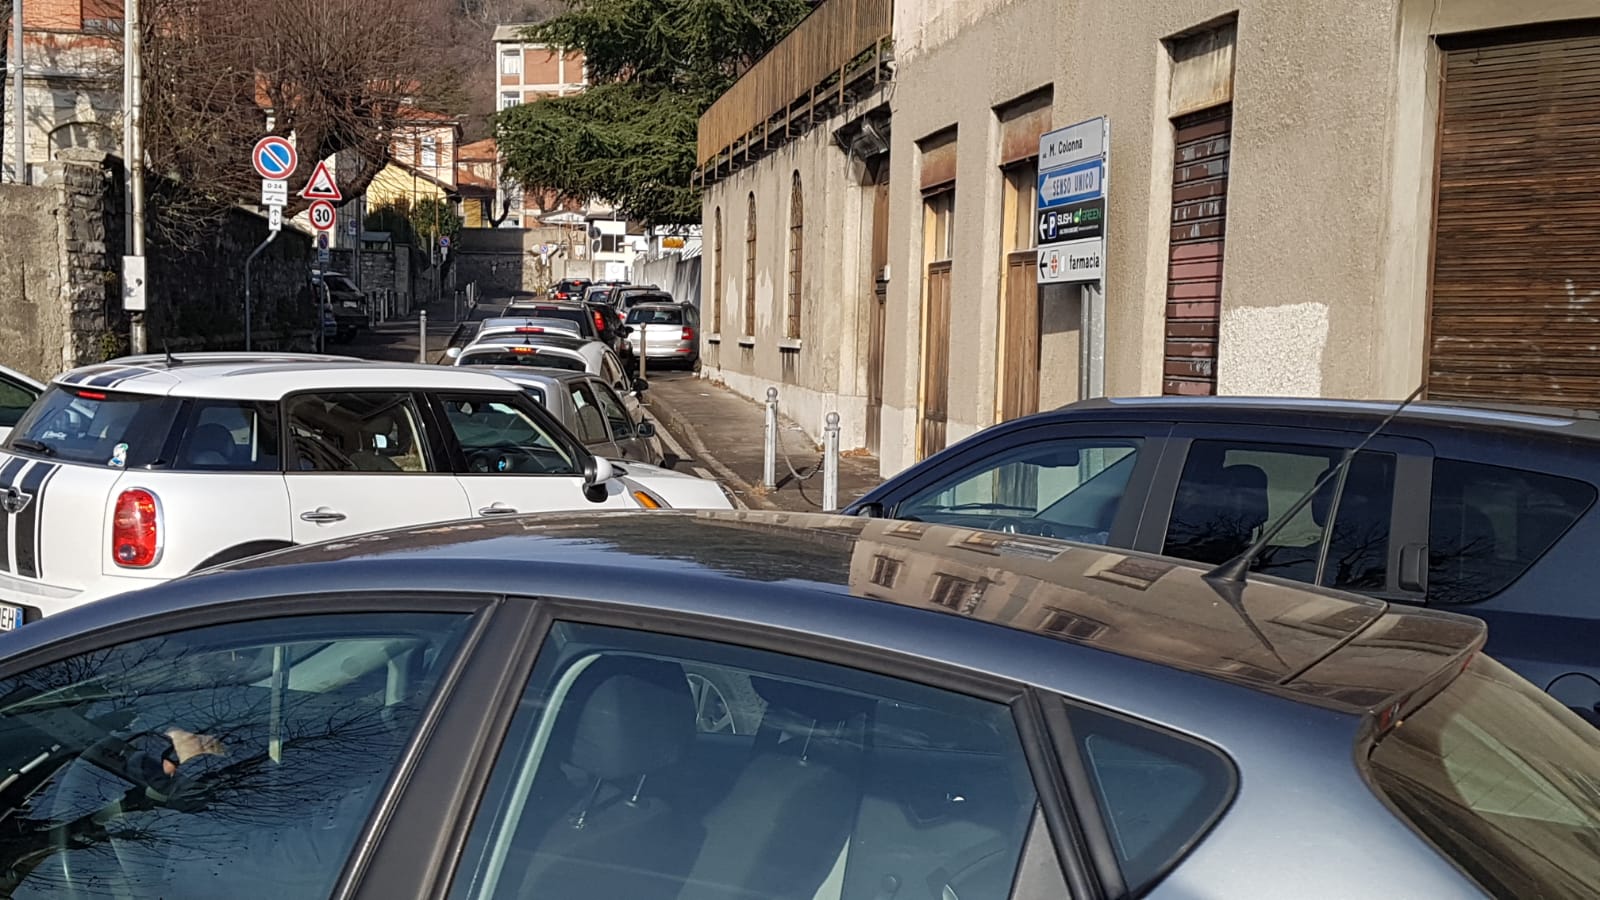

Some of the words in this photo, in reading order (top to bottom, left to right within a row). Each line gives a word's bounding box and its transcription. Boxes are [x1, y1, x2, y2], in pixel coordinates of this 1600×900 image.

[1058, 138, 1083, 154] Colonna
[1053, 176, 1072, 197] SENSO
[1074, 171, 1094, 192] UNICO
[315, 208, 330, 222] 30
[1069, 252, 1100, 271] farmacia
[0, 607, 14, 630] EH
